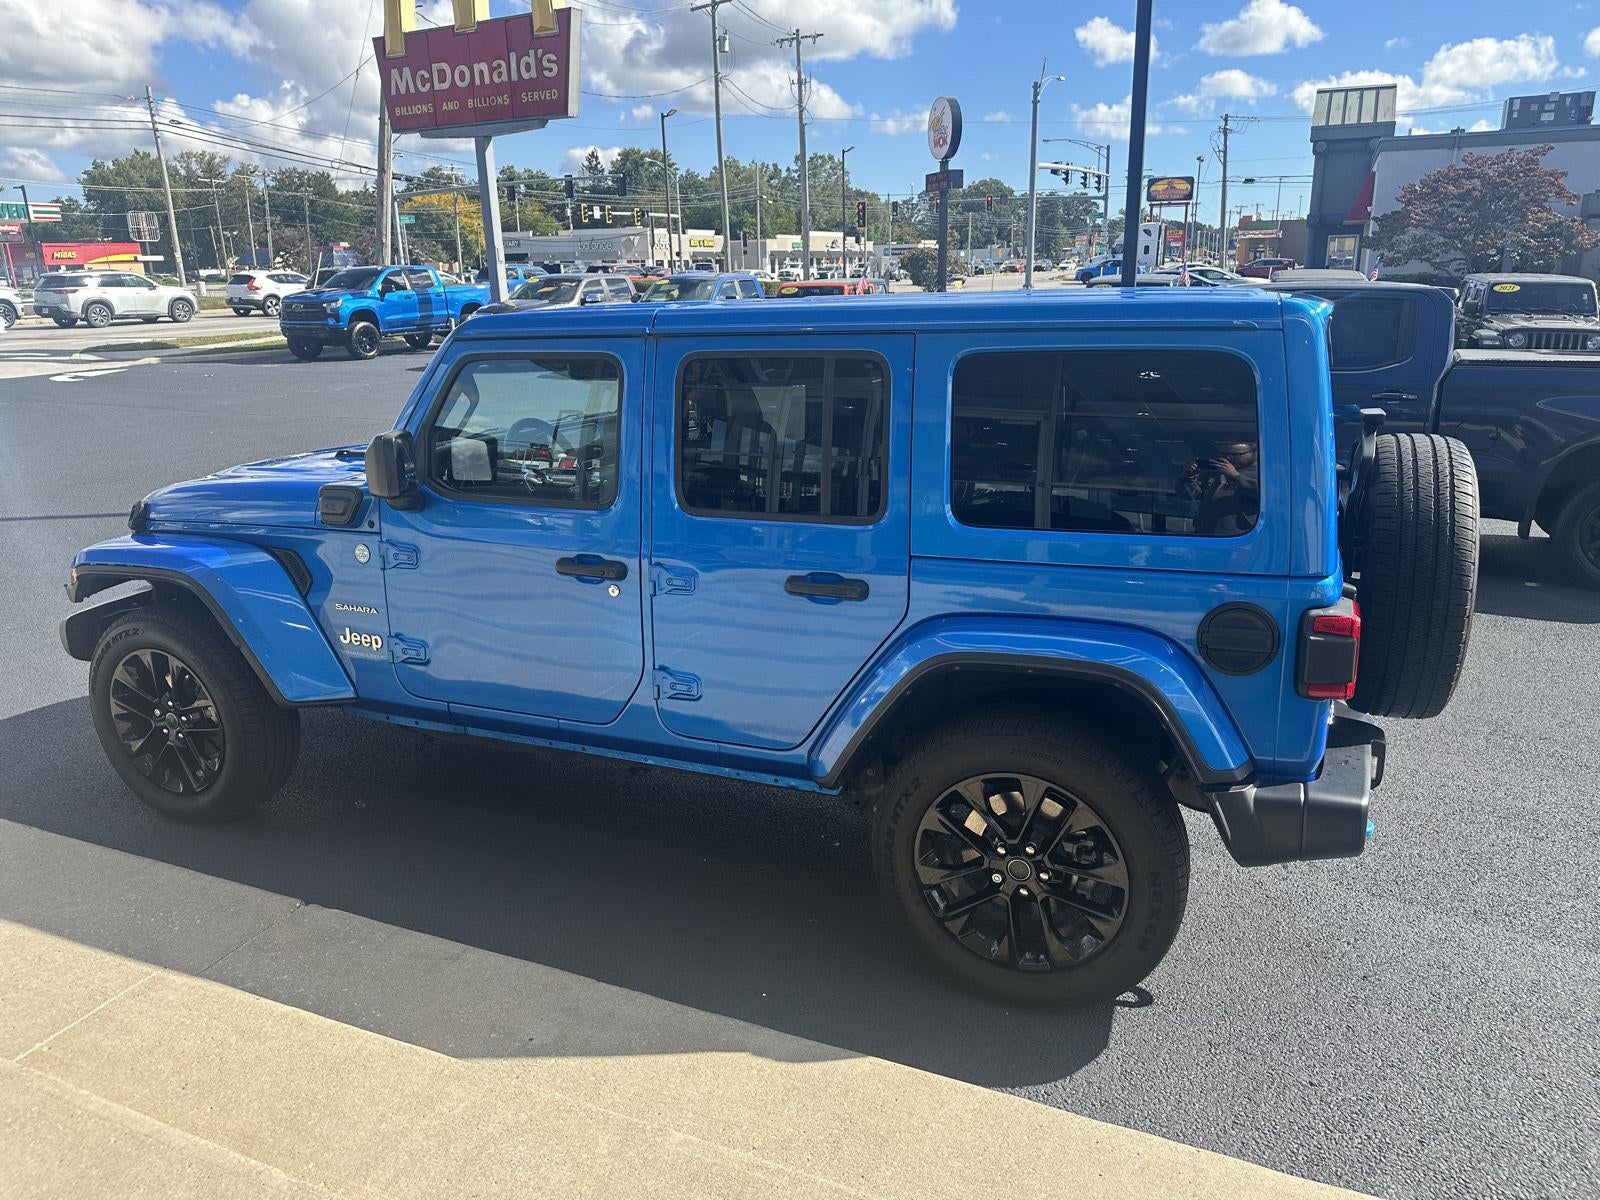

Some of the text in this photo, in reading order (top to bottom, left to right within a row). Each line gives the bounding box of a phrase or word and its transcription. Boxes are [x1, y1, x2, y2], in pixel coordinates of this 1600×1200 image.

[390, 48, 559, 96] McDonald's
[395, 88, 559, 117] BILLIONS AND BILLIONS SERVED
[53, 251, 77, 259] MIDAS
[335, 603, 378, 615] SAHARA
[340, 627, 383, 651] Jeep
